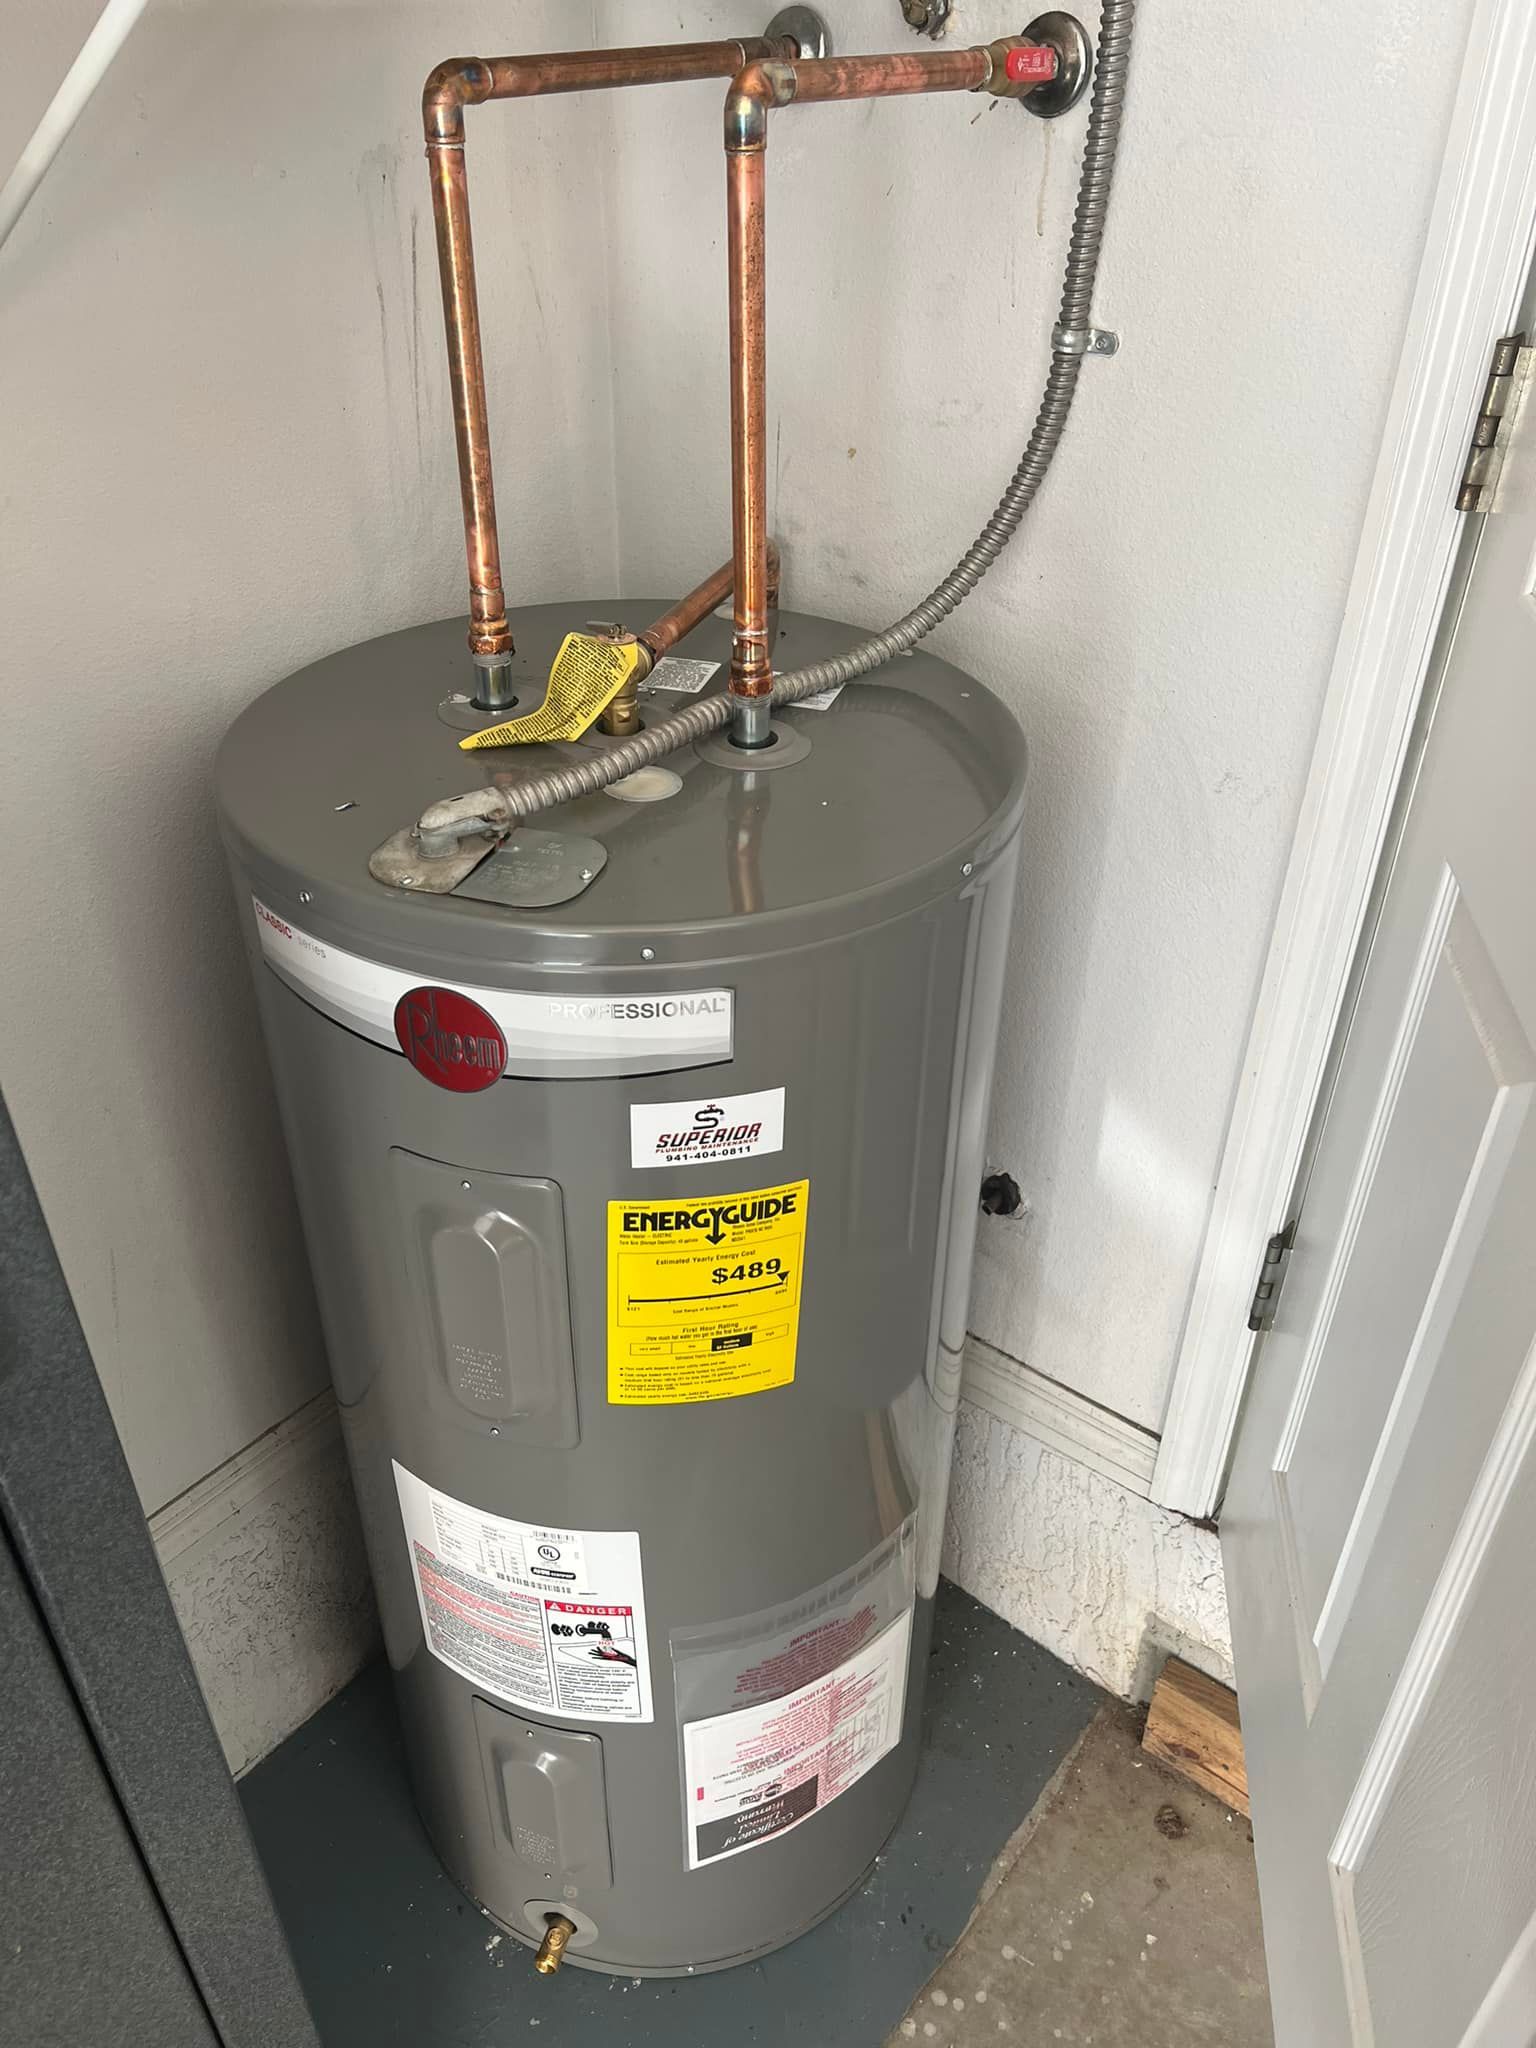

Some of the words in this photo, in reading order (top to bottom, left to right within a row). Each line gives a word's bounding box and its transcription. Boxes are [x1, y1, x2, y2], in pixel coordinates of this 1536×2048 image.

[255, 902, 292, 939] CLASSIC
[549, 997, 726, 1020] PROFESSIONAL
[406, 991, 501, 1075] Rheem
[655, 1122, 762, 1148] SUPERIOR
[655, 1145, 698, 1154] PLUMBING
[700, 1137, 759, 1150] MAINTENANCE
[665, 1145, 751, 1162] 941-404-0811
[623, 1193, 797, 1232] ENERGYGUIDE
[656, 1257, 690, 1265] Estimated
[693, 1255, 714, 1263] Yearly
[716, 1252, 739, 1261] Energy
[741, 1249, 756, 1257] Cost
[711, 1257, 781, 1285] $489
[718, 1322, 739, 1331] Rating
[565, 1604, 627, 1615] DANGER
[789, 1619, 840, 1648] IMPORTANT
[788, 1679, 836, 1710] IMPORTANT
